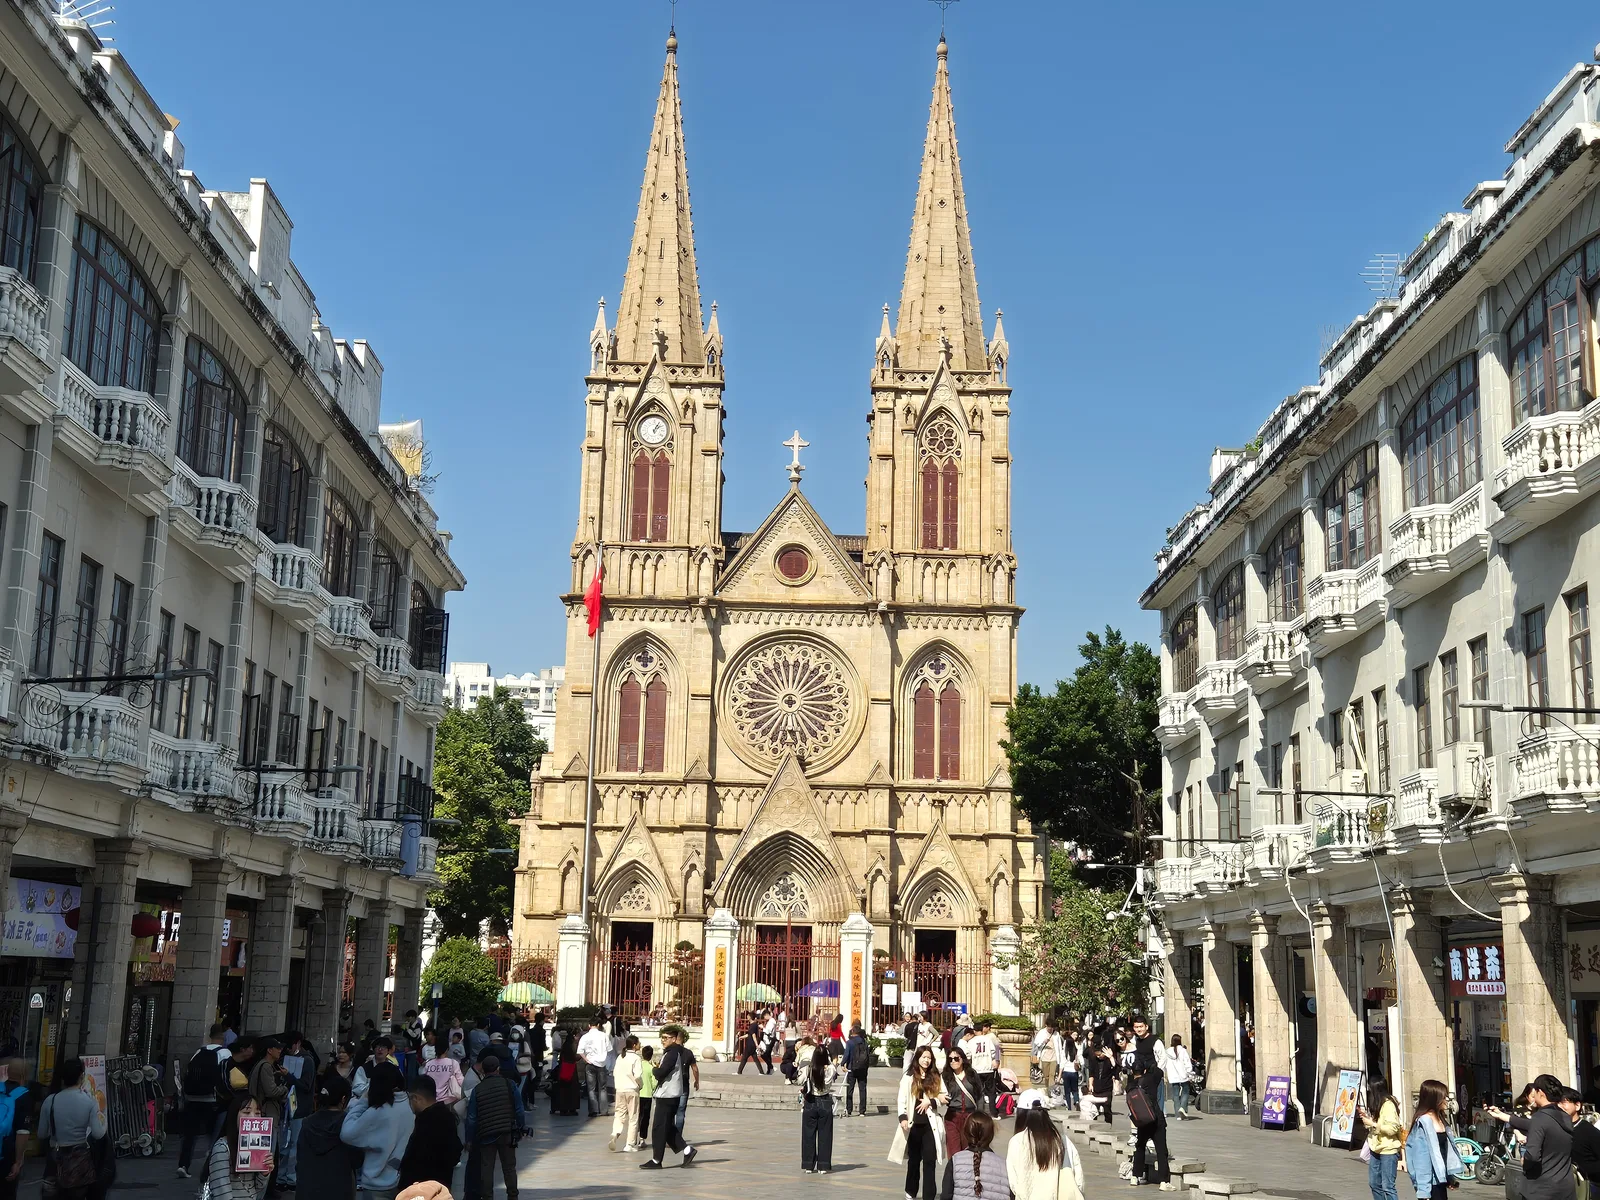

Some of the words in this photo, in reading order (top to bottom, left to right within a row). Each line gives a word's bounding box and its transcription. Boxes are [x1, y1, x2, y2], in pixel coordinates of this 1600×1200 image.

[1449, 945, 1500, 981] 南洋茶
[242, 1119, 269, 1131] 拍立得
